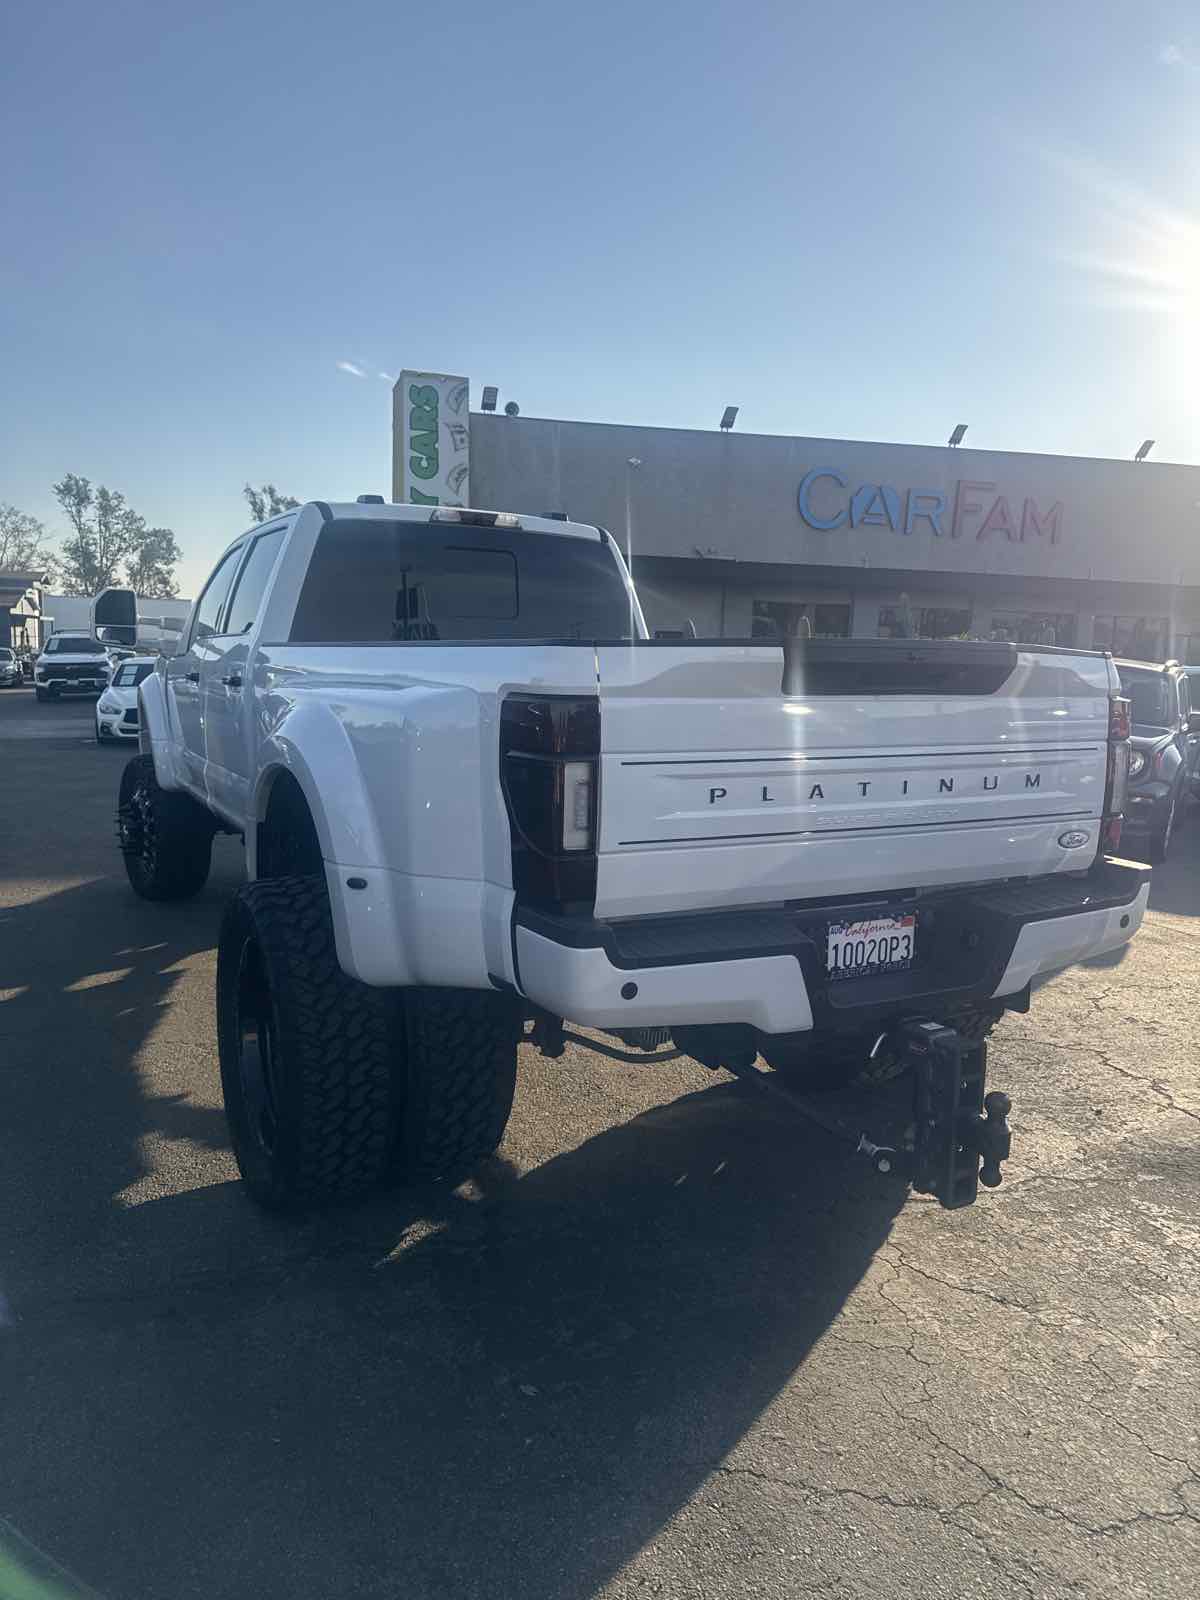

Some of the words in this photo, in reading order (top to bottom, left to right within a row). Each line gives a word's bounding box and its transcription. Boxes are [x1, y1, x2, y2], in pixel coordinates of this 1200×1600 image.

[409, 384, 439, 480] CARS
[709, 773, 1041, 804] PLATINUM
[845, 920, 900, 938] California
[832, 935, 911, 967] 10020P3
